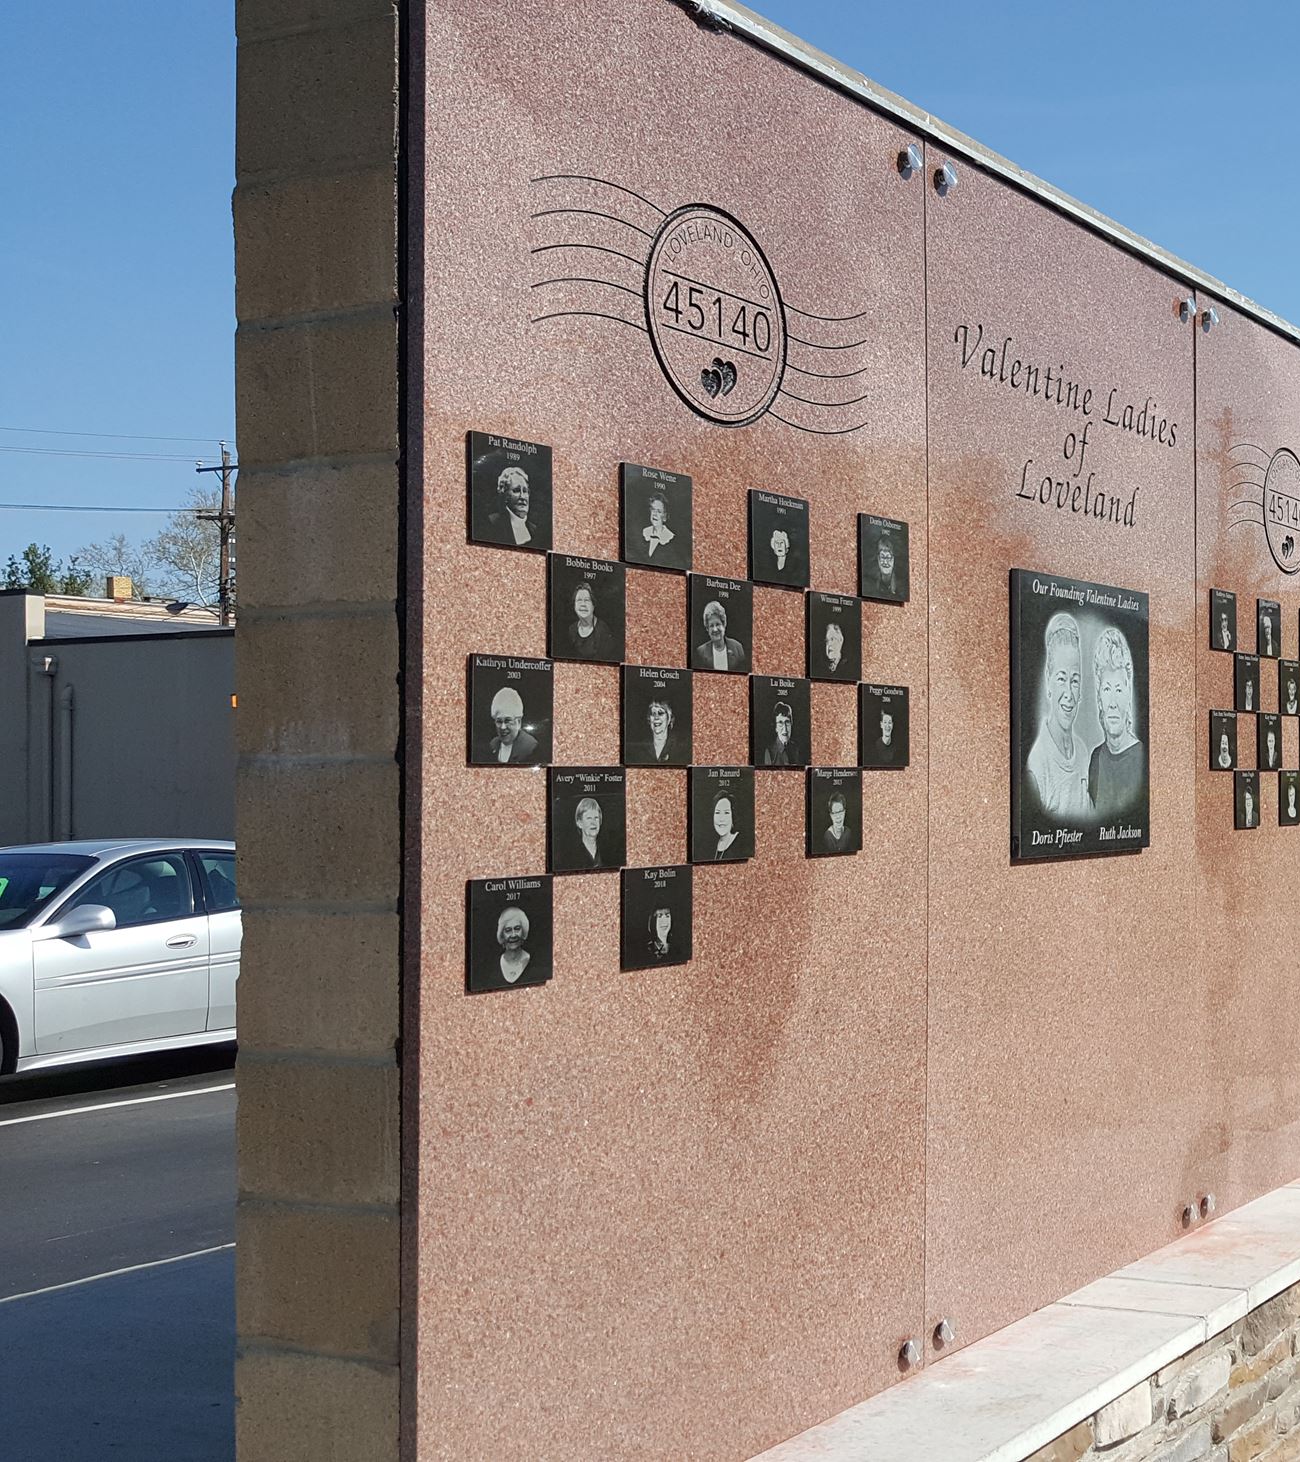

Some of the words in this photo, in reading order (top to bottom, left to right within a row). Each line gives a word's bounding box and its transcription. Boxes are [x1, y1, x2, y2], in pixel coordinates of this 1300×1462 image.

[741, 250, 769, 299] OHIO
[663, 281, 770, 352] 45140
[954, 324, 1093, 416] Valentine
[1102, 388, 1177, 447] Ladies
[488, 436, 501, 446] Pat
[502, 438, 537, 455] Randolph
[1063, 421, 1092, 477] of
[506, 452, 520, 461] 1989
[642, 468, 658, 479] Rose
[758, 493, 778, 504] Martha
[1016, 459, 1139, 528] Loveland
[566, 557, 591, 569] Bobbie
[592, 561, 613, 572] Books
[583, 571, 597, 580] 1997
[706, 578, 729, 589] Barbara
[1032, 579, 1048, 594] Our
[1049, 582, 1085, 606] Founding
[1086, 588, 1117, 607] Valentine
[1117, 594, 1139, 611] Ladies
[476, 656, 507, 670] Kathryn
[508, 658, 551, 671] Undercoffer
[507, 671, 521, 679] 2003
[639, 668, 659, 678] Helen
[659, 669, 680, 679] Gosch
[770, 678, 778, 686] Lu
[556, 773, 575, 784] Avery
[604, 774, 623, 782] Foster
[707, 769, 719, 777] Jan
[583, 784, 596, 792] 2011
[1031, 829, 1054, 846] Doris
[1055, 828, 1083, 848] Pfiester
[1099, 826, 1116, 840] Ruth
[1117, 824, 1142, 840] Jackson
[644, 870, 658, 881] Kay
[659, 868, 676, 878] Bolin
[485, 880, 506, 892] Carol
[508, 879, 541, 890] Williams
[506, 892, 521, 901] 2017
